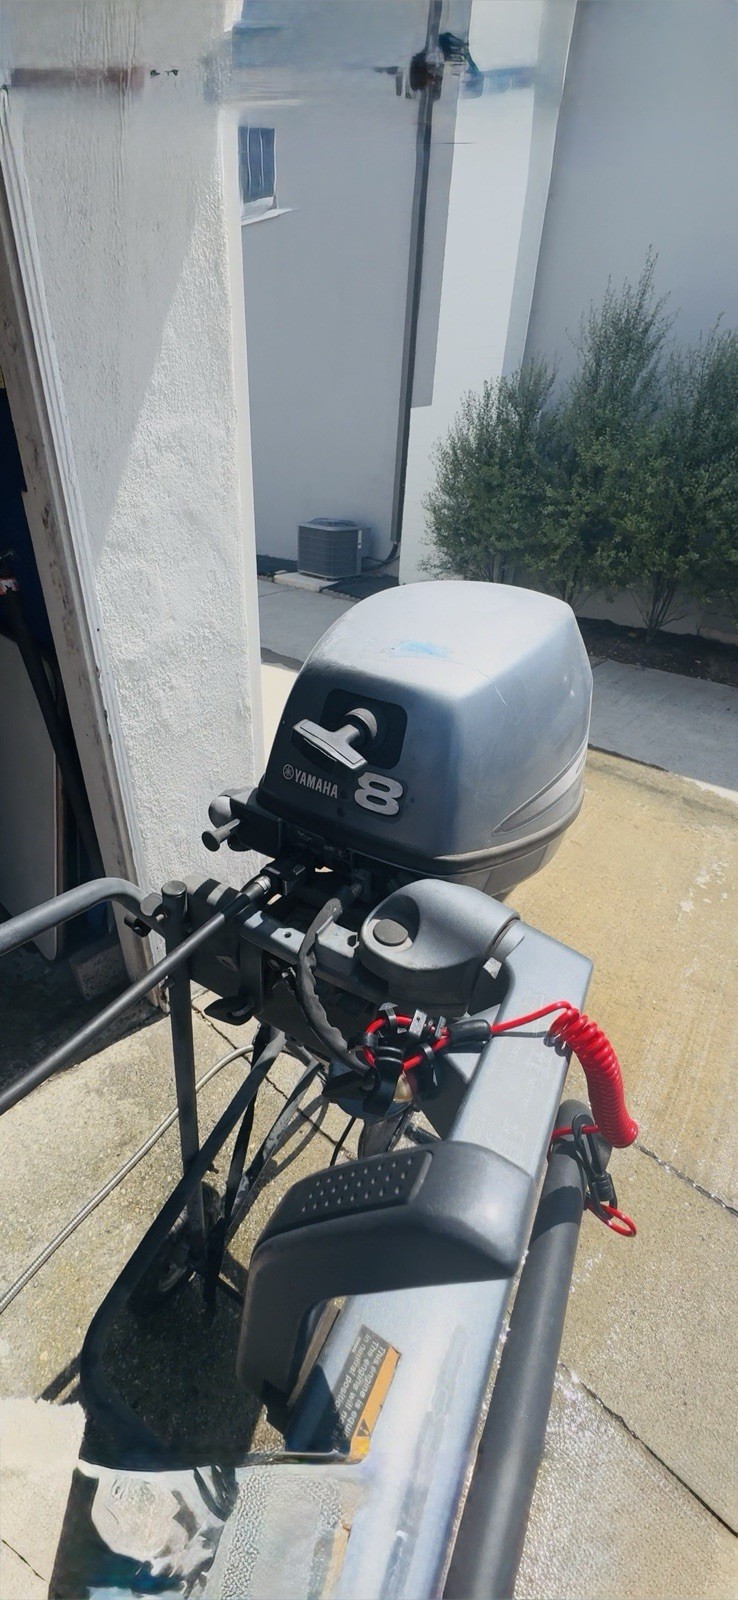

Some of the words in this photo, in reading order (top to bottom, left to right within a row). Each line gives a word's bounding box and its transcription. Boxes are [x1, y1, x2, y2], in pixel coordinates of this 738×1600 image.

[294, 768, 338, 798] YAMAHA
[354, 771, 404, 816] 8
[364, 1333, 372, 1343] in
[367, 1341, 380, 1357] The
[373, 1347, 387, 1365] This
[352, 1359, 370, 1391] engine
[360, 1366, 377, 1398] engine
[345, 1392, 356, 1410] will
[354, 1399, 364, 1410] is
